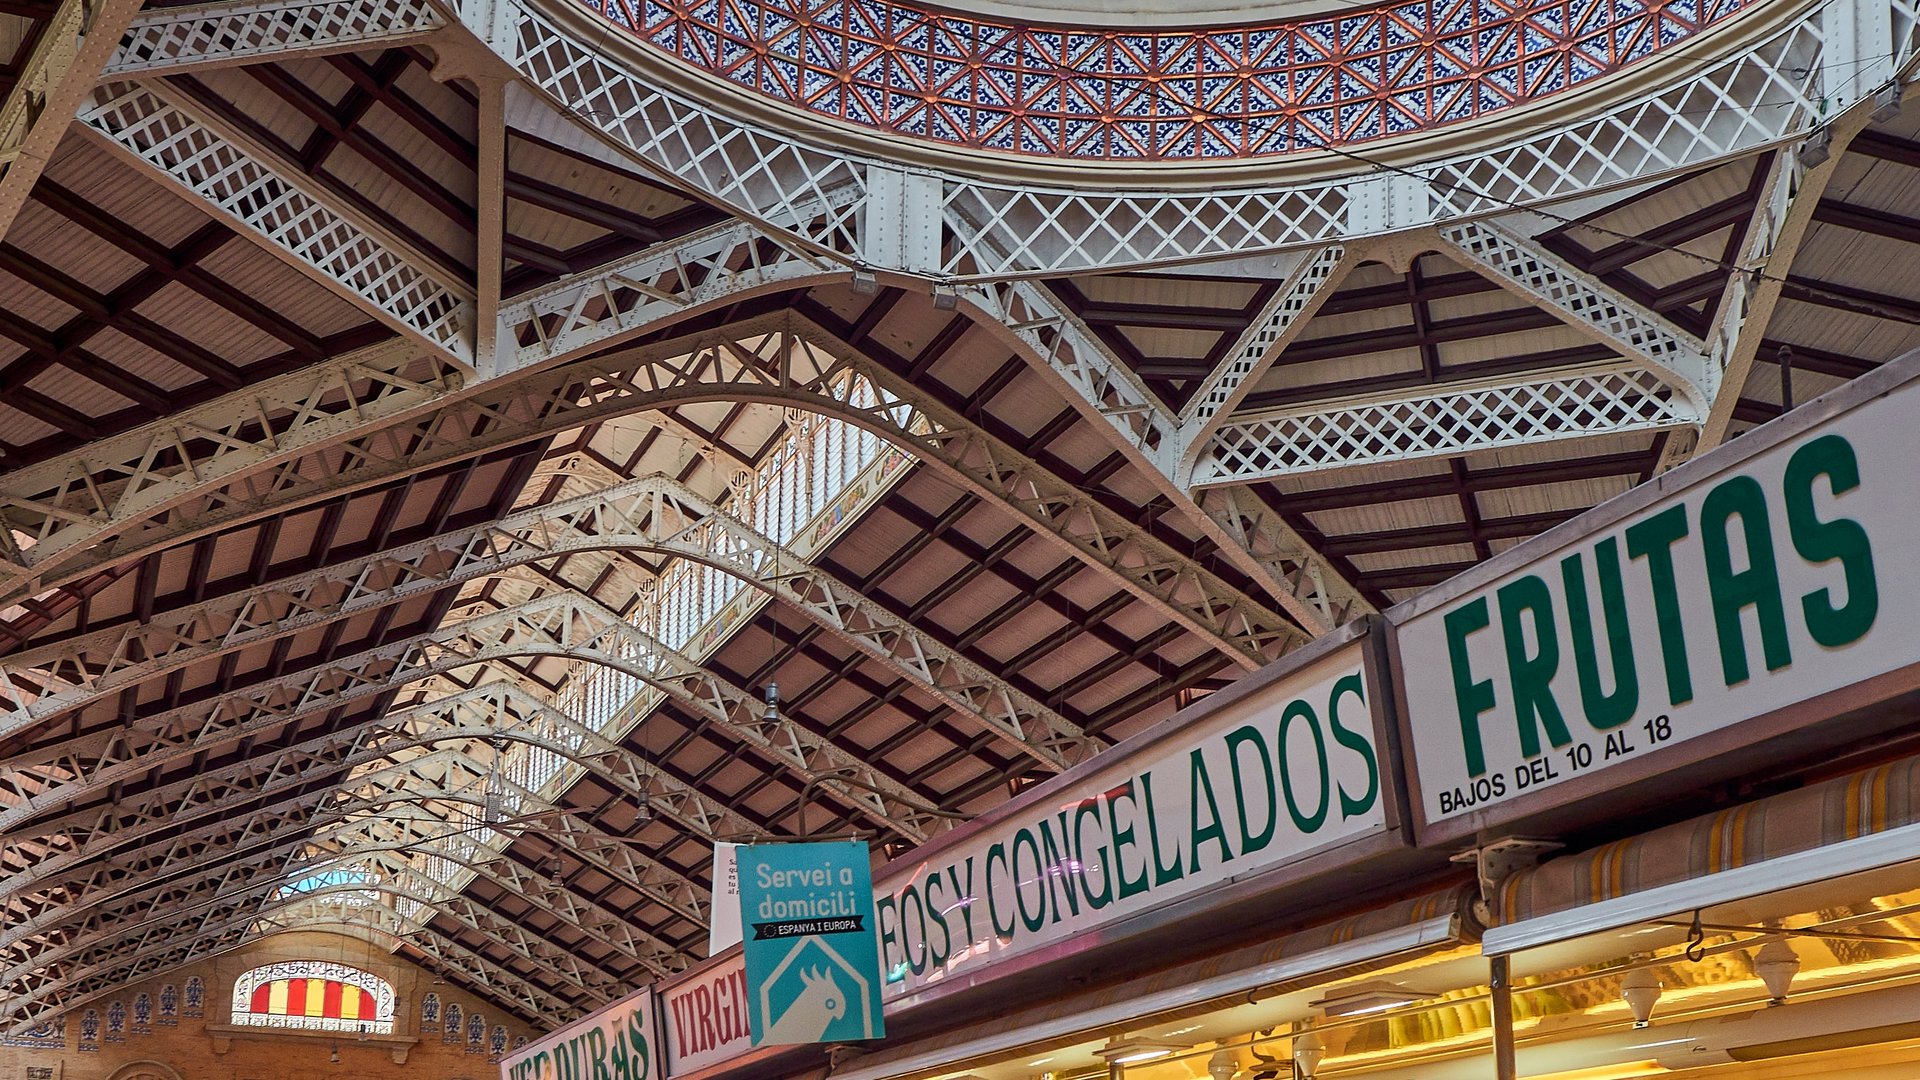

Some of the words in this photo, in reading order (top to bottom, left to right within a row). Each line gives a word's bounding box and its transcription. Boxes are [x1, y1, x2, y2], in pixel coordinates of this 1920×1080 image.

[1443, 433, 1879, 779] FRUTAS
[1439, 772, 1506, 815] BAJOS
[1515, 757, 1559, 790] DEL
[1566, 743, 1593, 771] 10
[1604, 730, 1635, 760] AL
[1643, 714, 1673, 744] 18
[946, 857, 974, 948] Y
[985, 669, 1379, 945] CONGELADOS
[757, 862, 832, 889] Servei
[840, 867, 853, 886] a
[759, 891, 856, 919] domicili
[778, 923, 816, 935] ESPANYA
[817, 922, 823, 932] I
[823, 920, 857, 931] EUROPA
